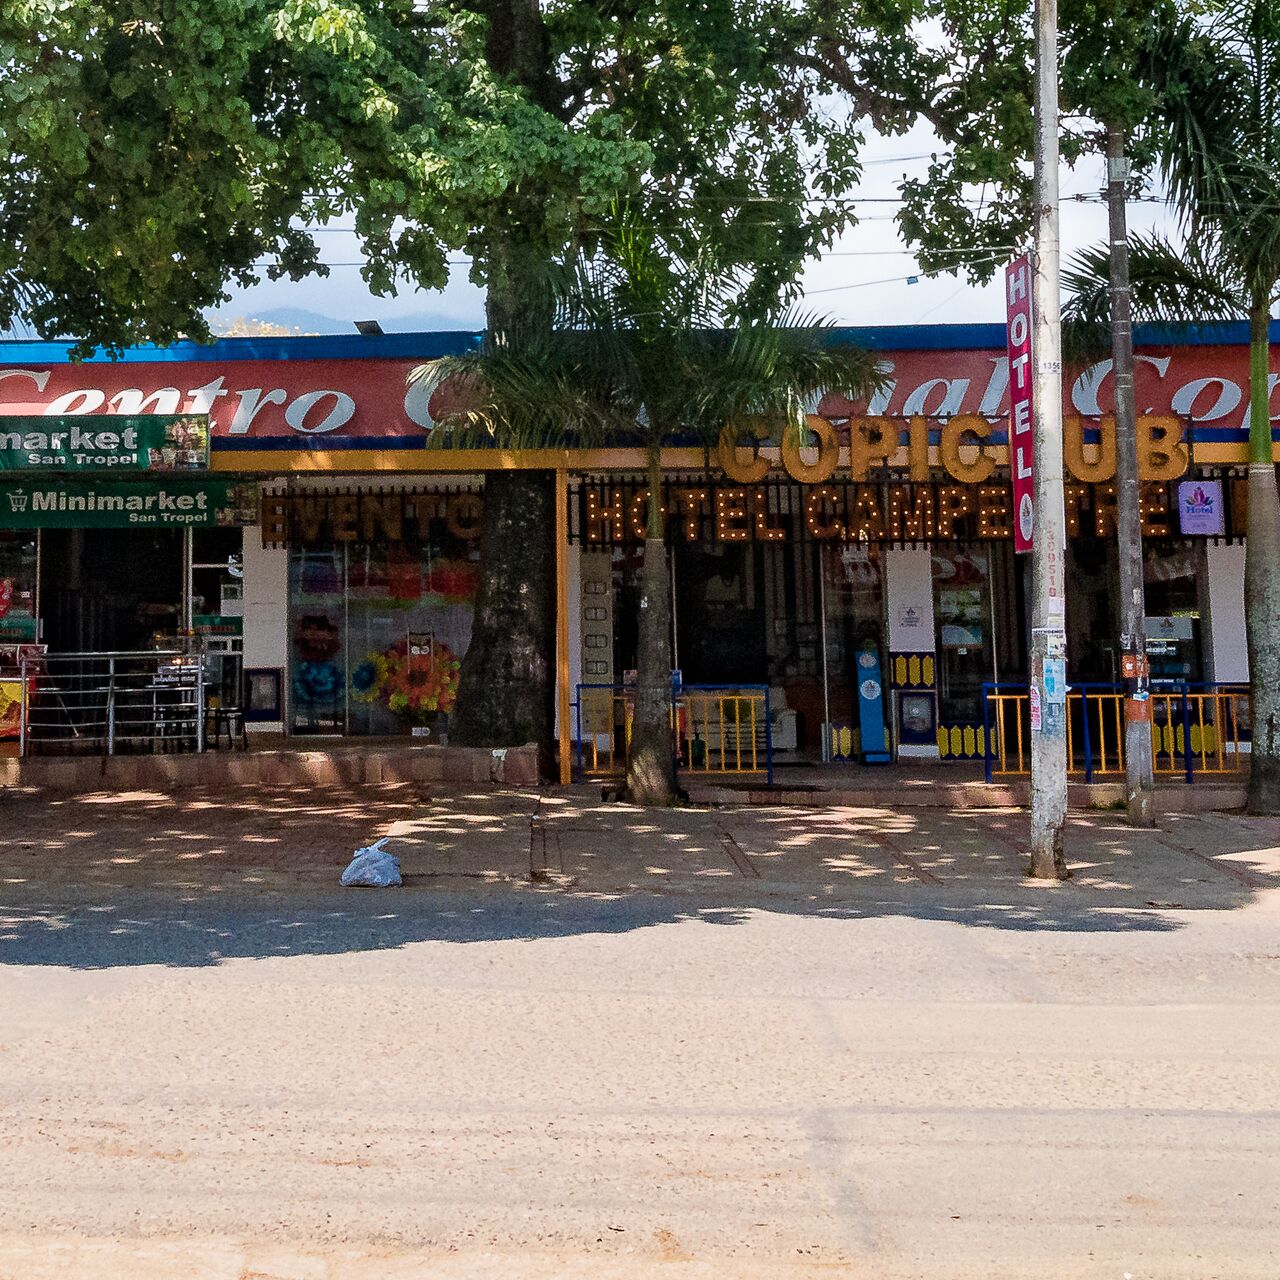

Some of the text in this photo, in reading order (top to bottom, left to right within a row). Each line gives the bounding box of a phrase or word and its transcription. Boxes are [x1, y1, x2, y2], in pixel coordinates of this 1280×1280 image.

[1007, 267, 1032, 480] HOTEL
[719, 412, 1189, 483] COPICUB
[28, 453, 138, 467] San Tropel
[33, 491, 207, 511] Minimarket
[1186, 506, 1213, 514] Hotel
[129, 513, 207, 523] San Tropel
[588, 485, 1170, 542] HOTEL CAMPETRE
